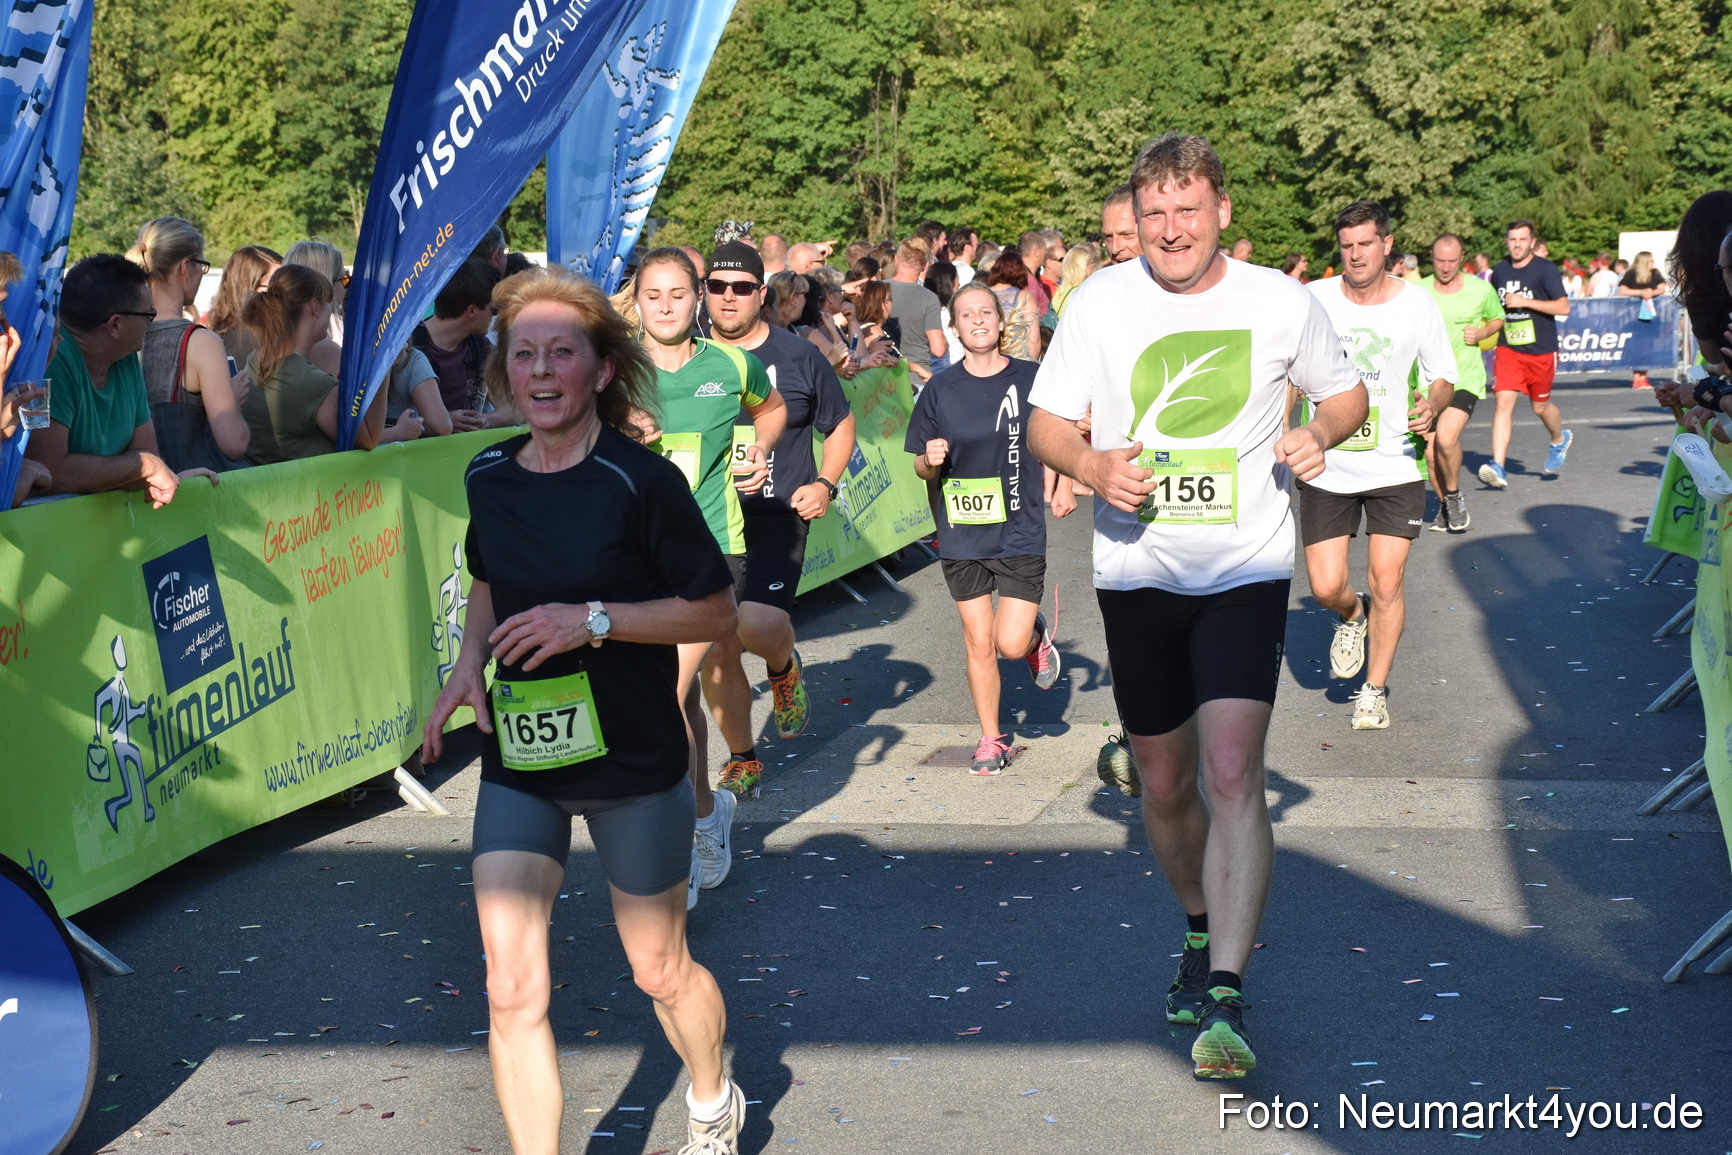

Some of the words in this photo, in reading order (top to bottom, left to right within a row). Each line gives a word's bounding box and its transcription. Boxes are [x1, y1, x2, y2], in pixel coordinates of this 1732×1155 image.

[515, 29, 565, 103] Druck
[560, 0, 592, 31] un
[1509, 330, 1527, 339] 292
[1558, 351, 1623, 362] OMOBILE
[695, 382, 726, 394] AOK
[1008, 422, 1021, 511] RAIL.ONE
[952, 494, 994, 511] 1607
[1158, 475, 1216, 502] 156
[1205, 503, 1233, 511] Markus
[264, 489, 333, 564] Gesunde
[334, 479, 384, 527] Firmen
[301, 546, 352, 605] laufen
[349, 508, 406, 579] länger!
[164, 583, 210, 621] Fischer
[172, 605, 212, 633] AUTOMOBILE
[146, 616, 296, 778] firmenlauf
[502, 706, 578, 746] 1657
[516, 745, 543, 755] Hilbich
[545, 742, 571, 755] Lydia
[535, 753, 560, 762] Stiftung
[560, 743, 597, 758] Lauterhofen
[160, 741, 221, 806] neumarkt
